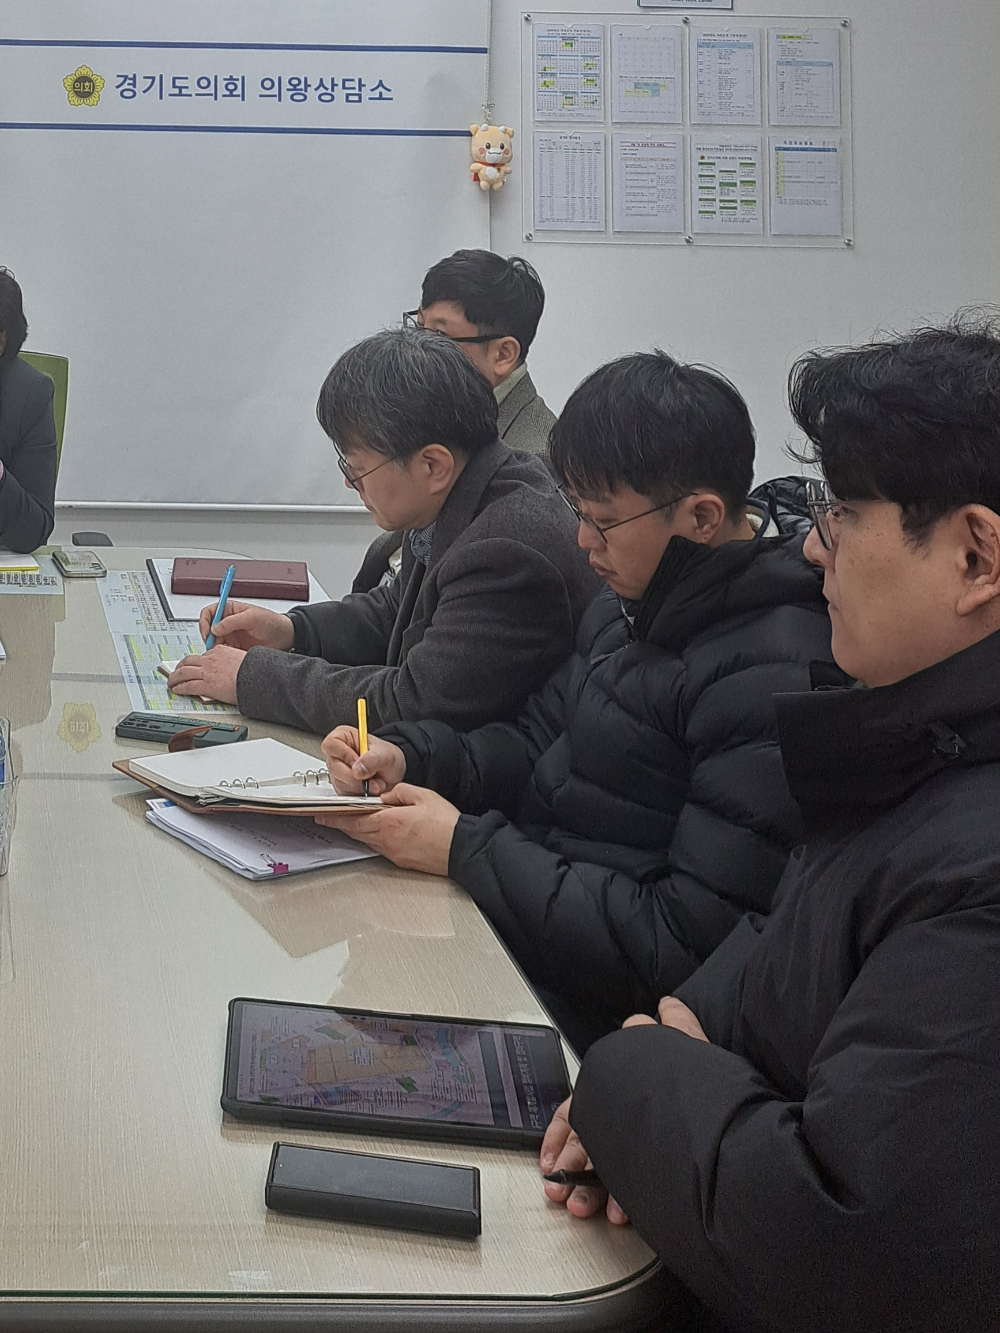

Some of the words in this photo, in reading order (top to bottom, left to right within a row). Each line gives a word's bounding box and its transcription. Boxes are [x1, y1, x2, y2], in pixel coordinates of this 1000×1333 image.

[73, 81, 93, 93] 의회
[114, 72, 248, 102] 경기도의회
[258, 75, 395, 105] 의왕상담소
